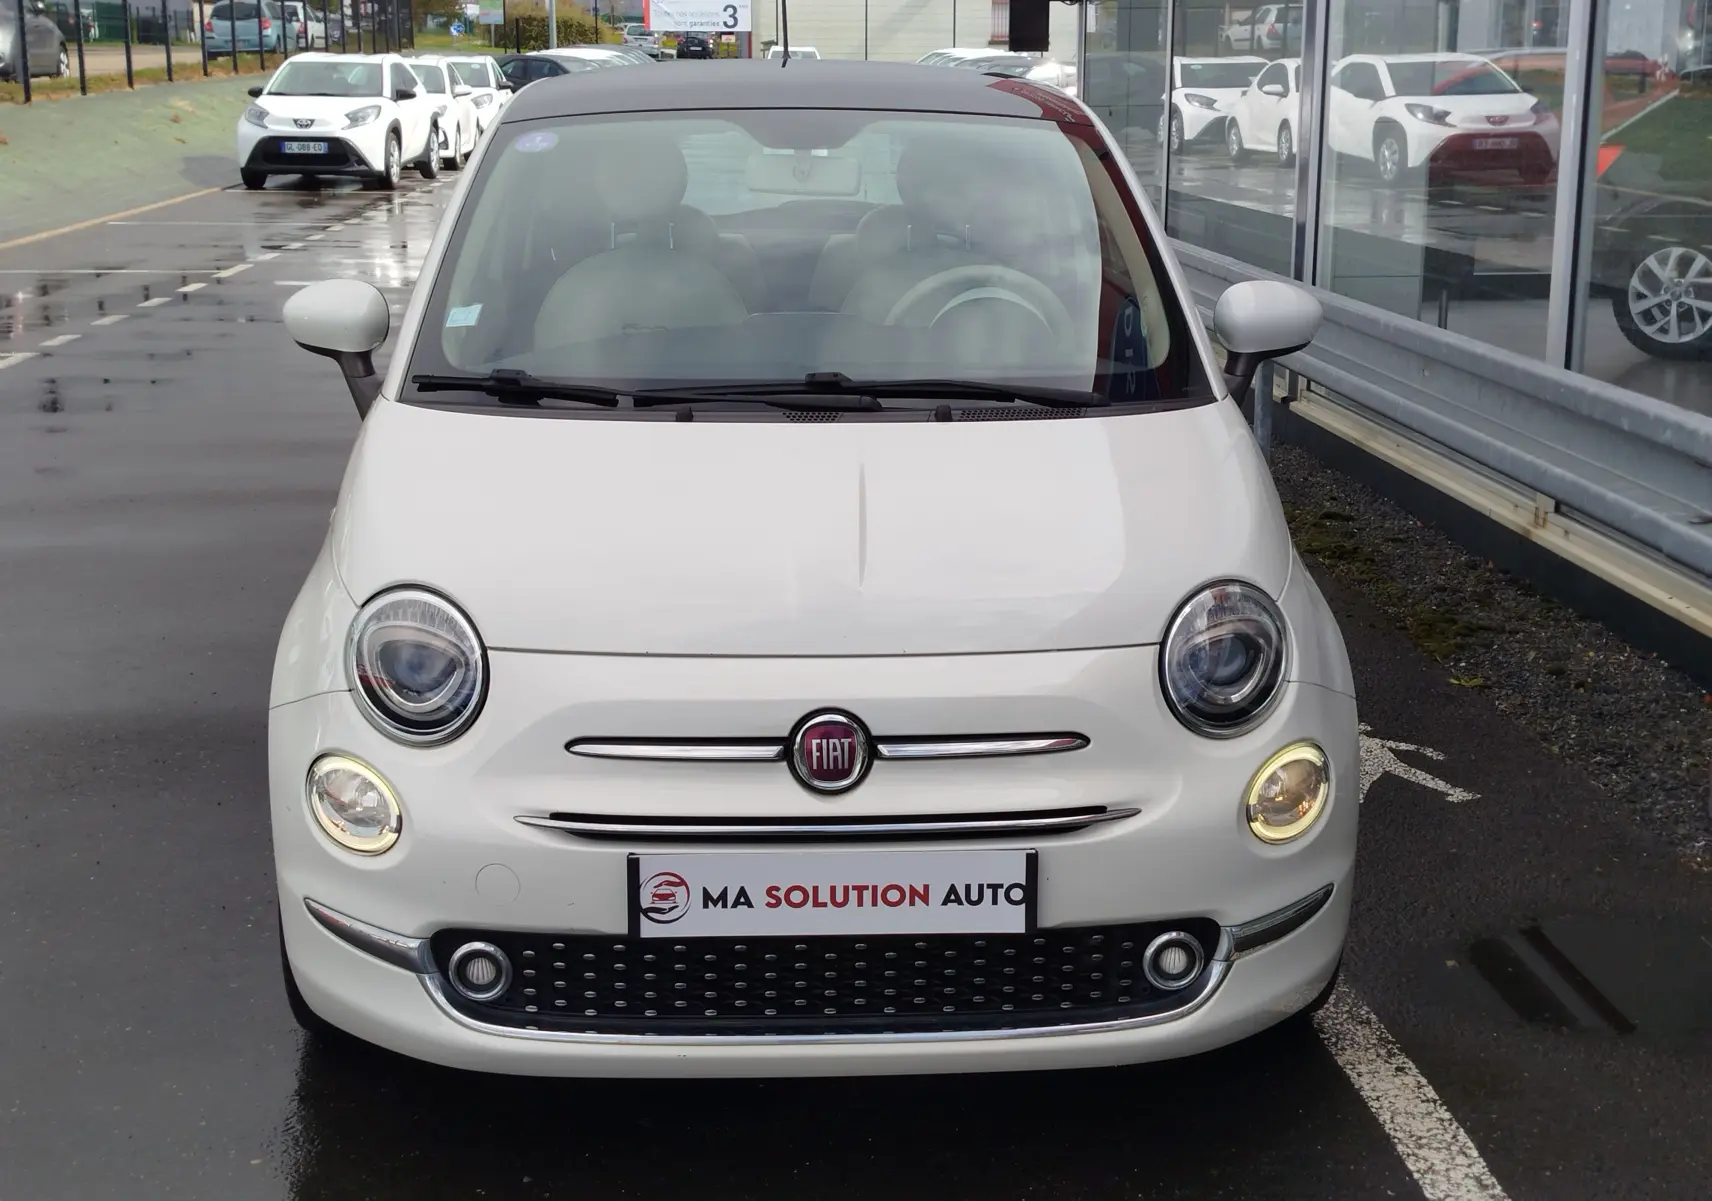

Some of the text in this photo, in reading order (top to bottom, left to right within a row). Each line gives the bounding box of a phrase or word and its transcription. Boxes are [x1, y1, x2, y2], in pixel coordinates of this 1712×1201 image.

[689, 20, 720, 28] garanties
[723, 4, 739, 29] 3
[811, 738, 852, 770] FIAT
[702, 882, 1027, 909] MA SOLUTION AUTO
